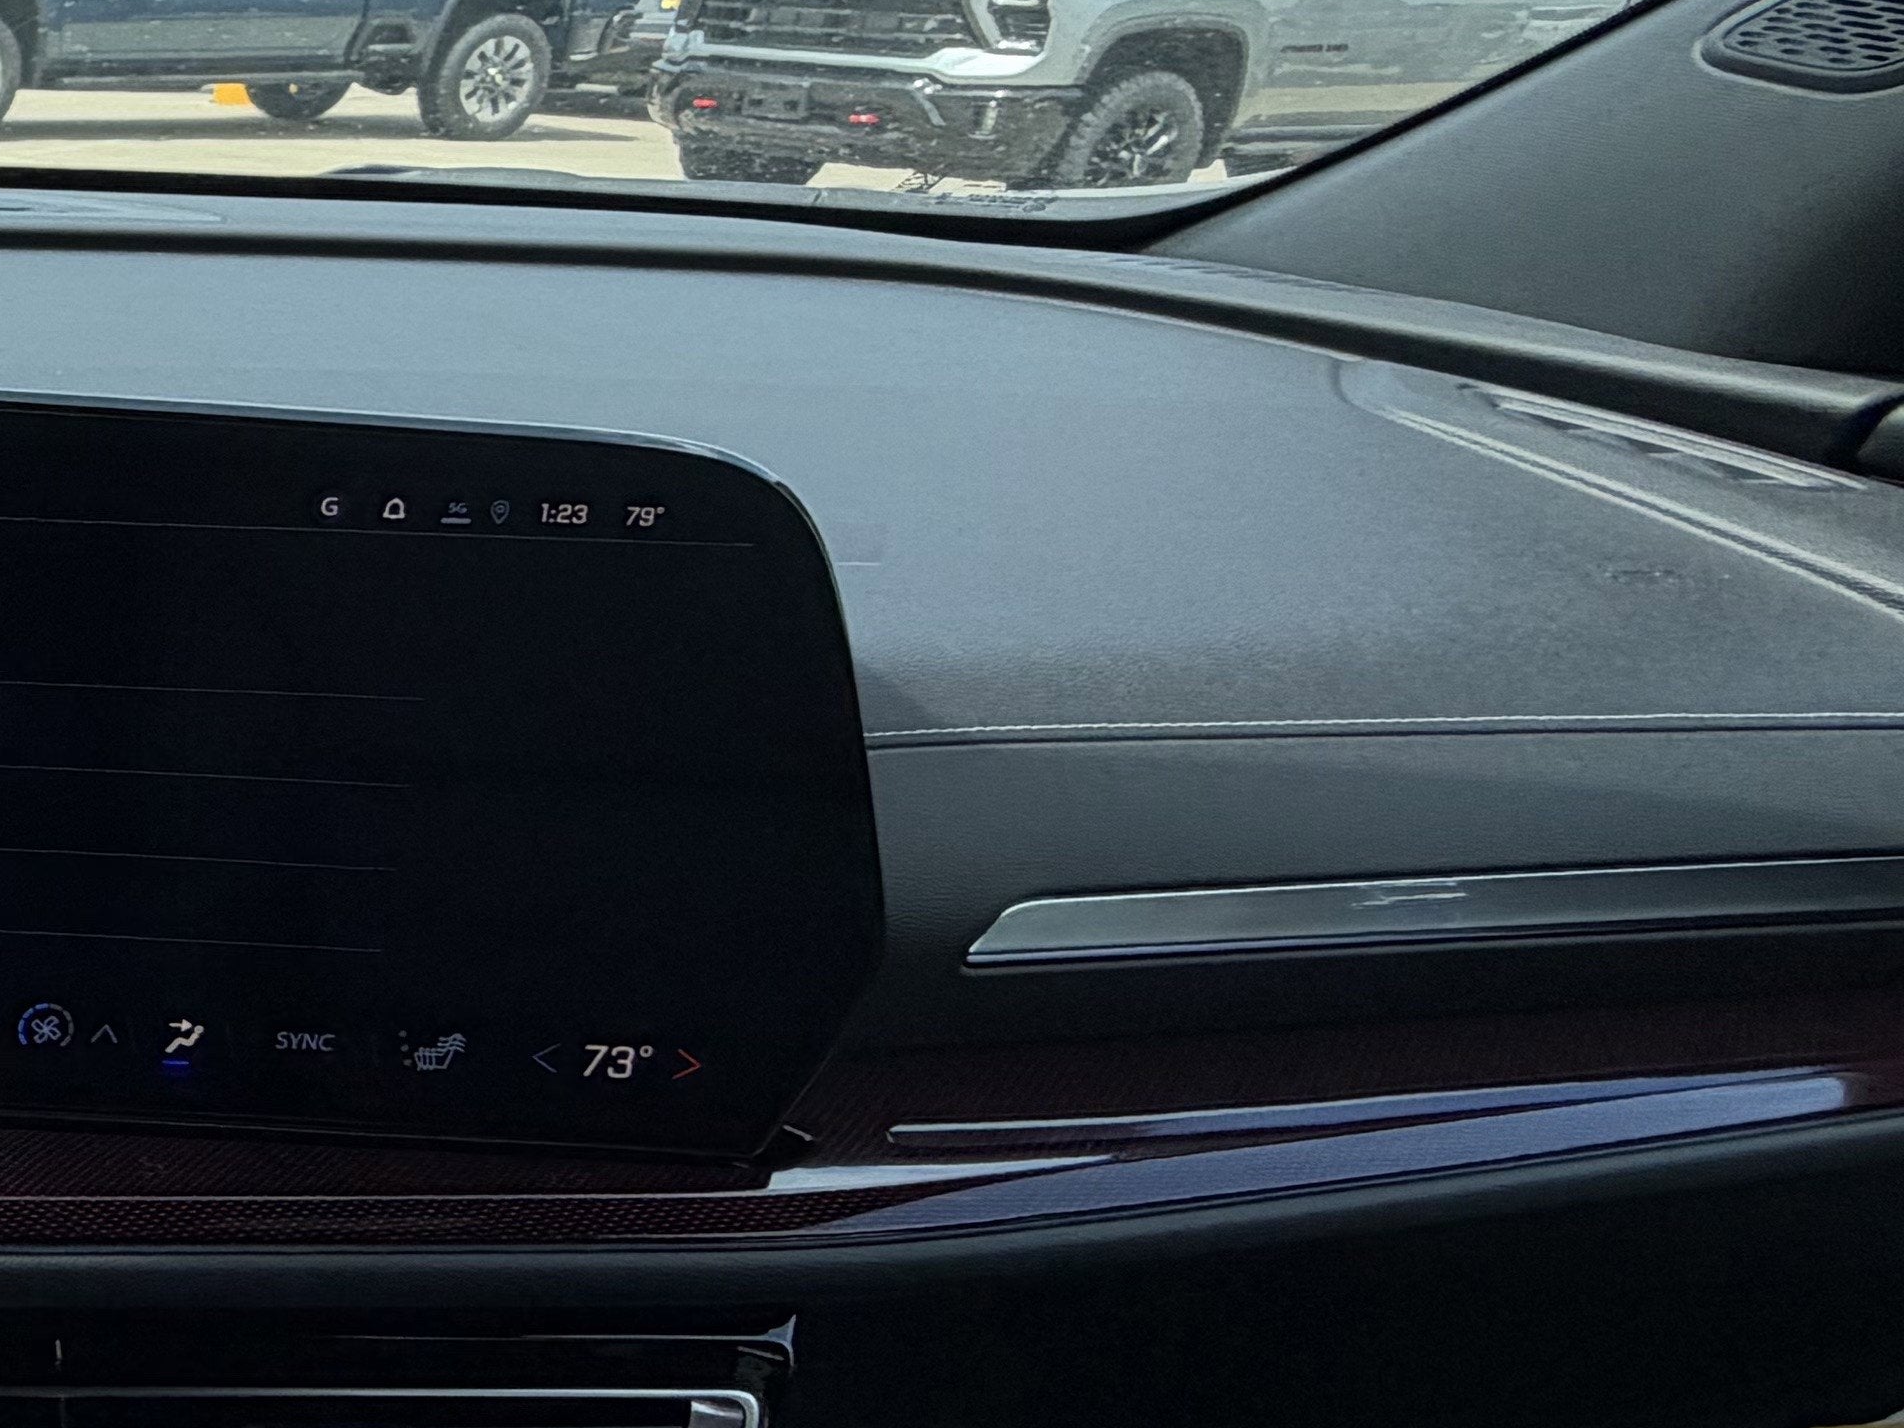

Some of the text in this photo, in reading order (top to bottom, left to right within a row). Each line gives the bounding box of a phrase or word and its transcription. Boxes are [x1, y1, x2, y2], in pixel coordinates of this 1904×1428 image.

[541, 503, 589, 524] 1:23
[626, 506, 665, 527] 79°
[275, 1031, 336, 1052] SYNC
[583, 1044, 654, 1079] 73°
